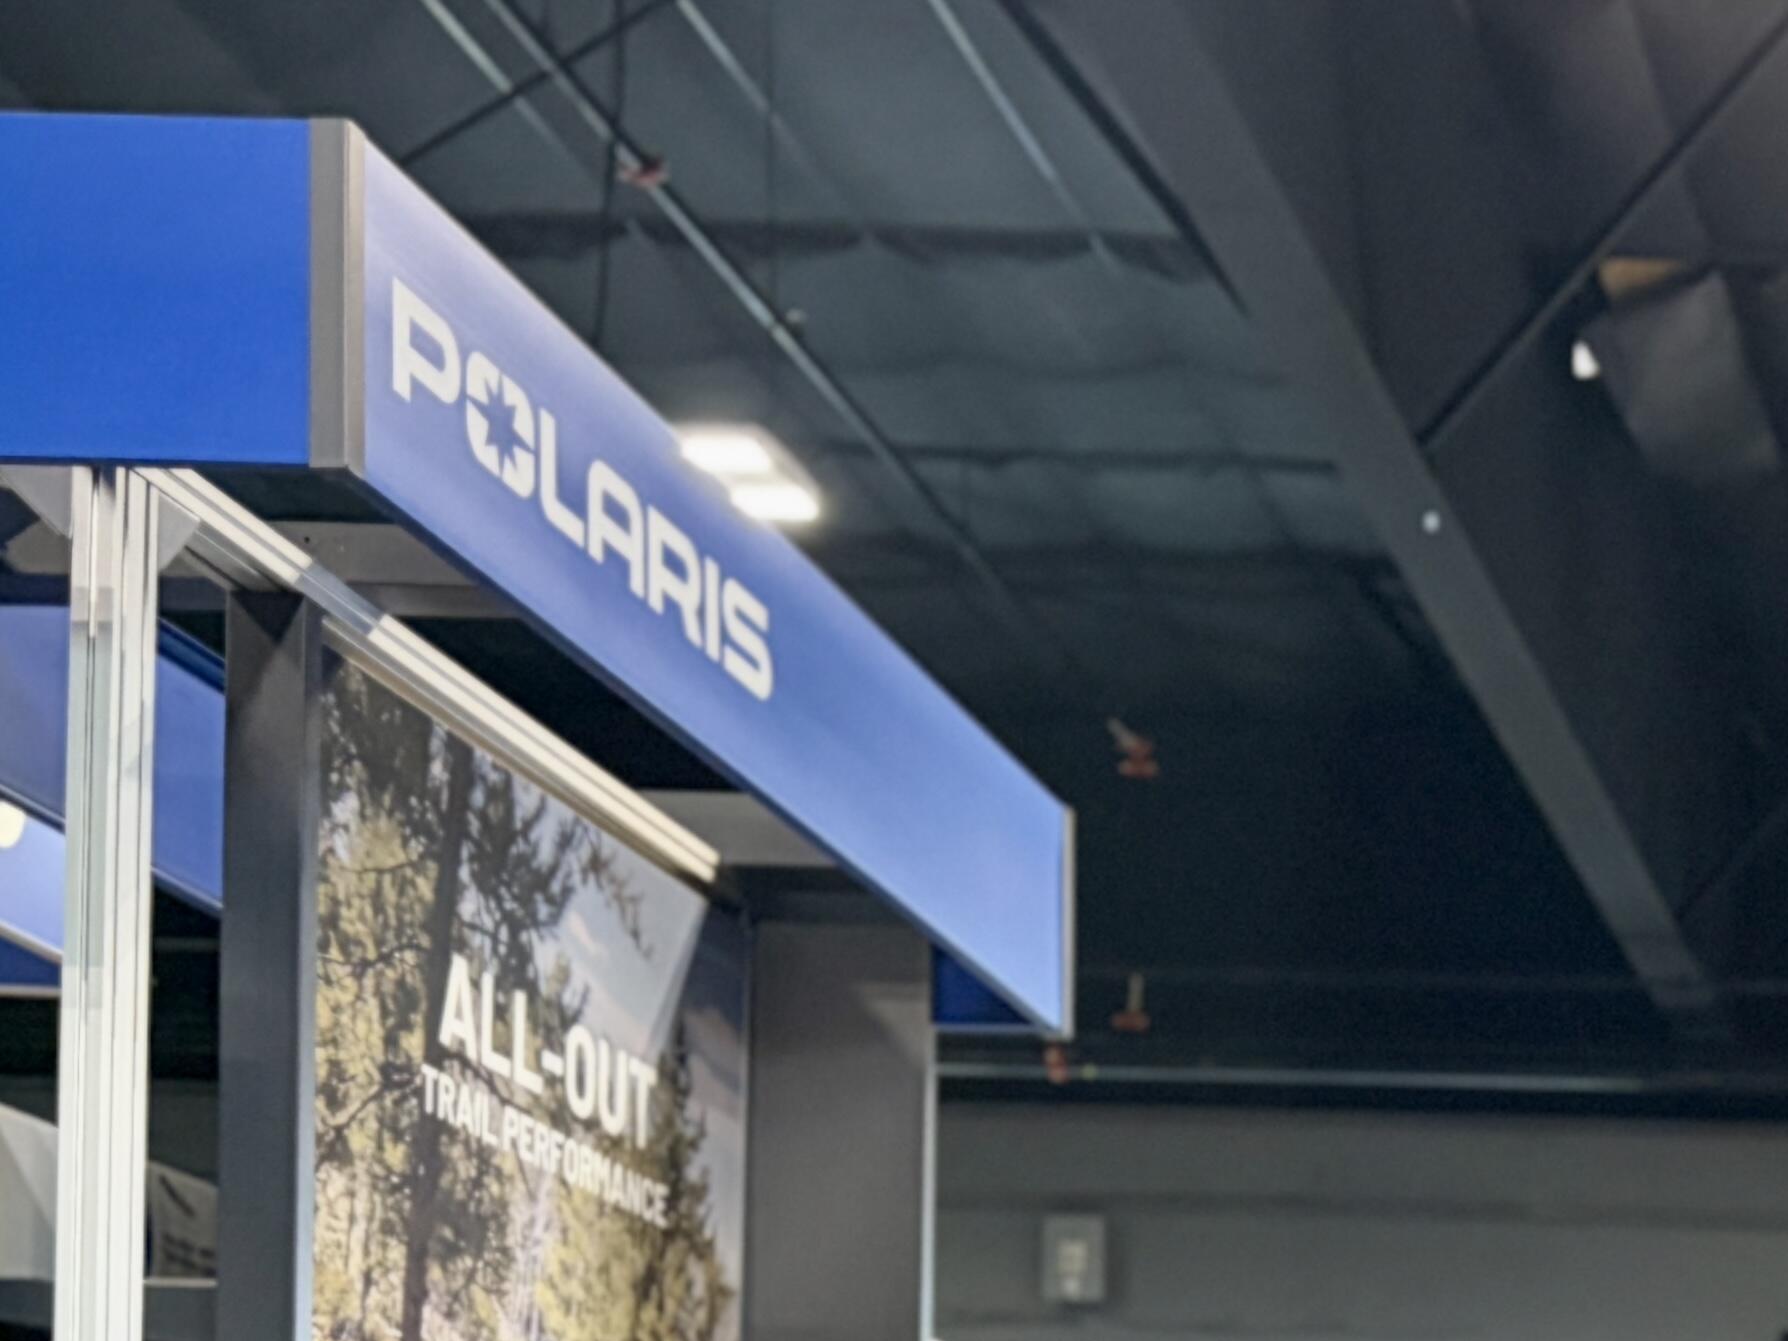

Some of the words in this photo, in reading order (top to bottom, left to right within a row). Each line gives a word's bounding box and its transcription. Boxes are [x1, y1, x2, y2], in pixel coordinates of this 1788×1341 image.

[391, 275, 775, 703] POLARIS
[420, 1062, 499, 1148] TRAIL
[502, 1104, 670, 1229] PERFORMANCE
[439, 952, 658, 1149] ALL-OUT
